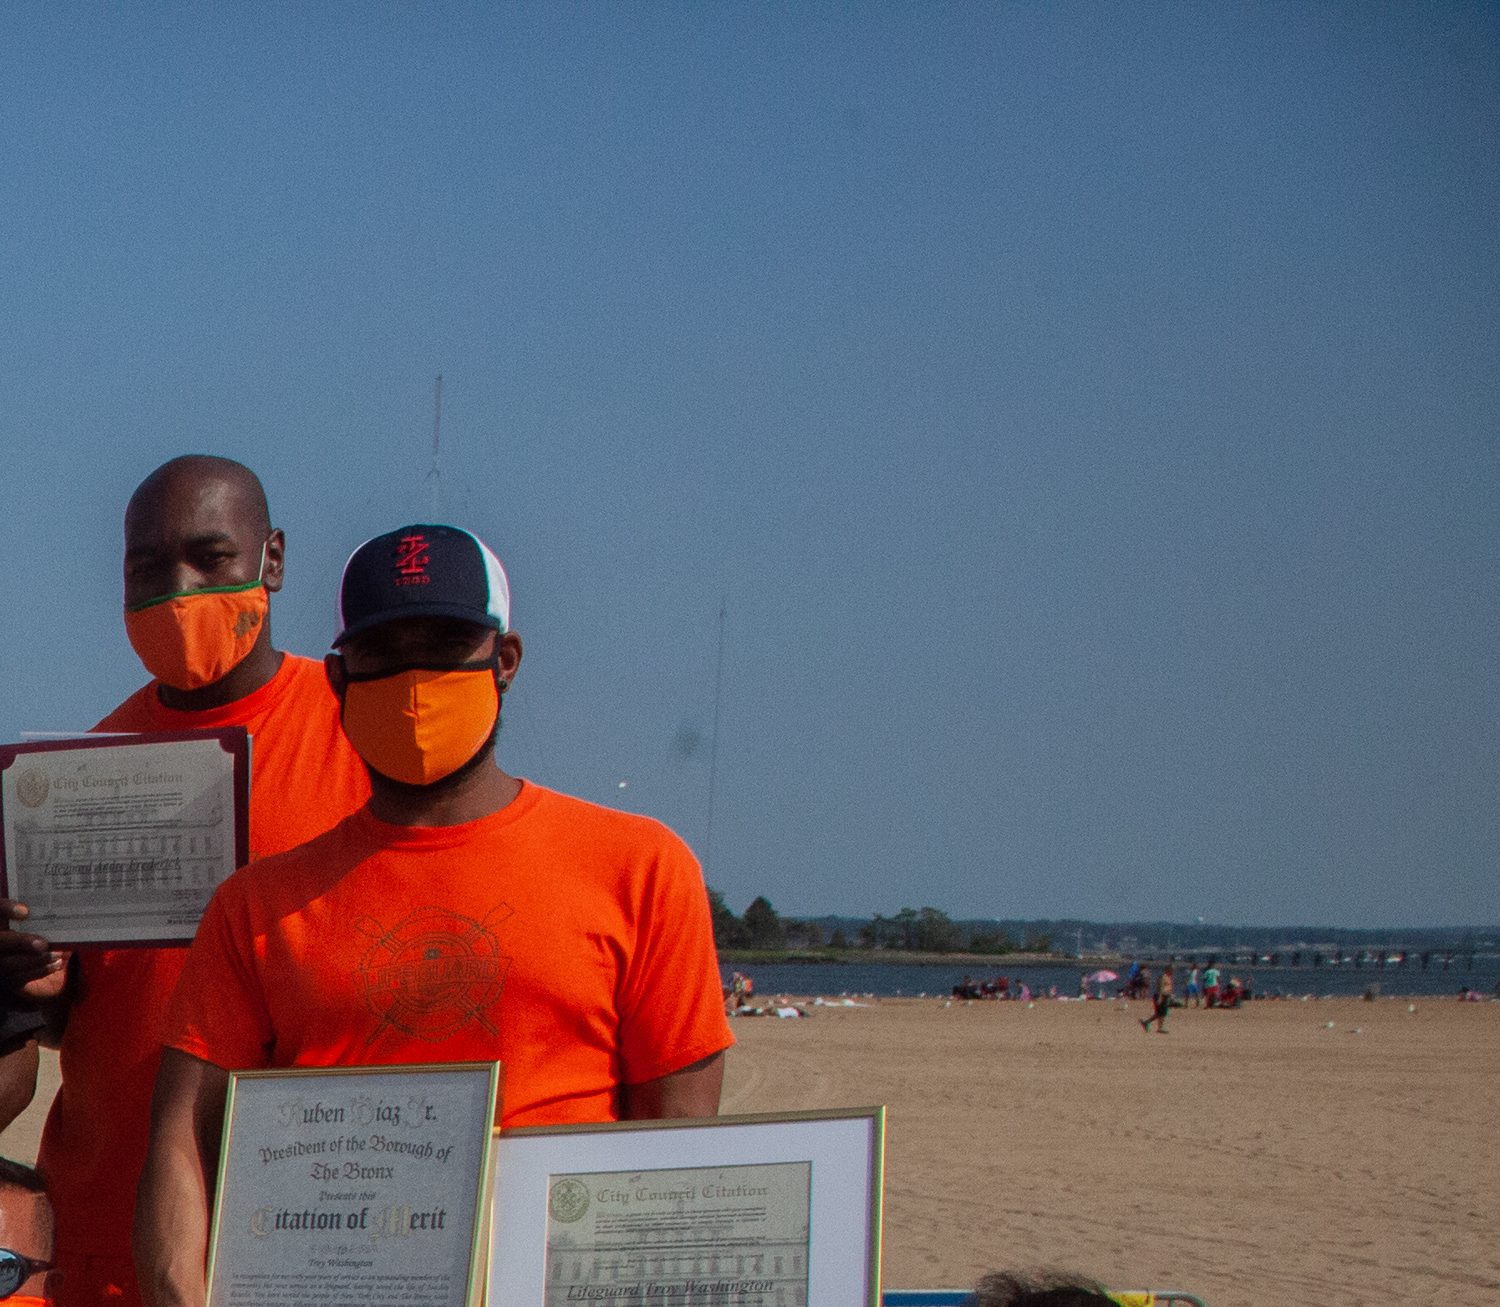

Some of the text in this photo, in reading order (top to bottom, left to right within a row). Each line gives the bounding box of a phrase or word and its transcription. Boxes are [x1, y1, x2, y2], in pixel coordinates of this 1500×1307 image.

[53, 776, 79, 791] City
[132, 771, 183, 786] Citation
[362, 959, 499, 991] LIFEGUARD
[277, 1101, 345, 1128] Ruben
[258, 1134, 454, 1166] President of the Borough of
[309, 1162, 394, 1183] The Bronx
[596, 1184, 768, 1204] City Council Citation
[249, 1205, 448, 1241] Citation of Merit
[566, 1279, 774, 1300] Lifeguard Troy Washington
